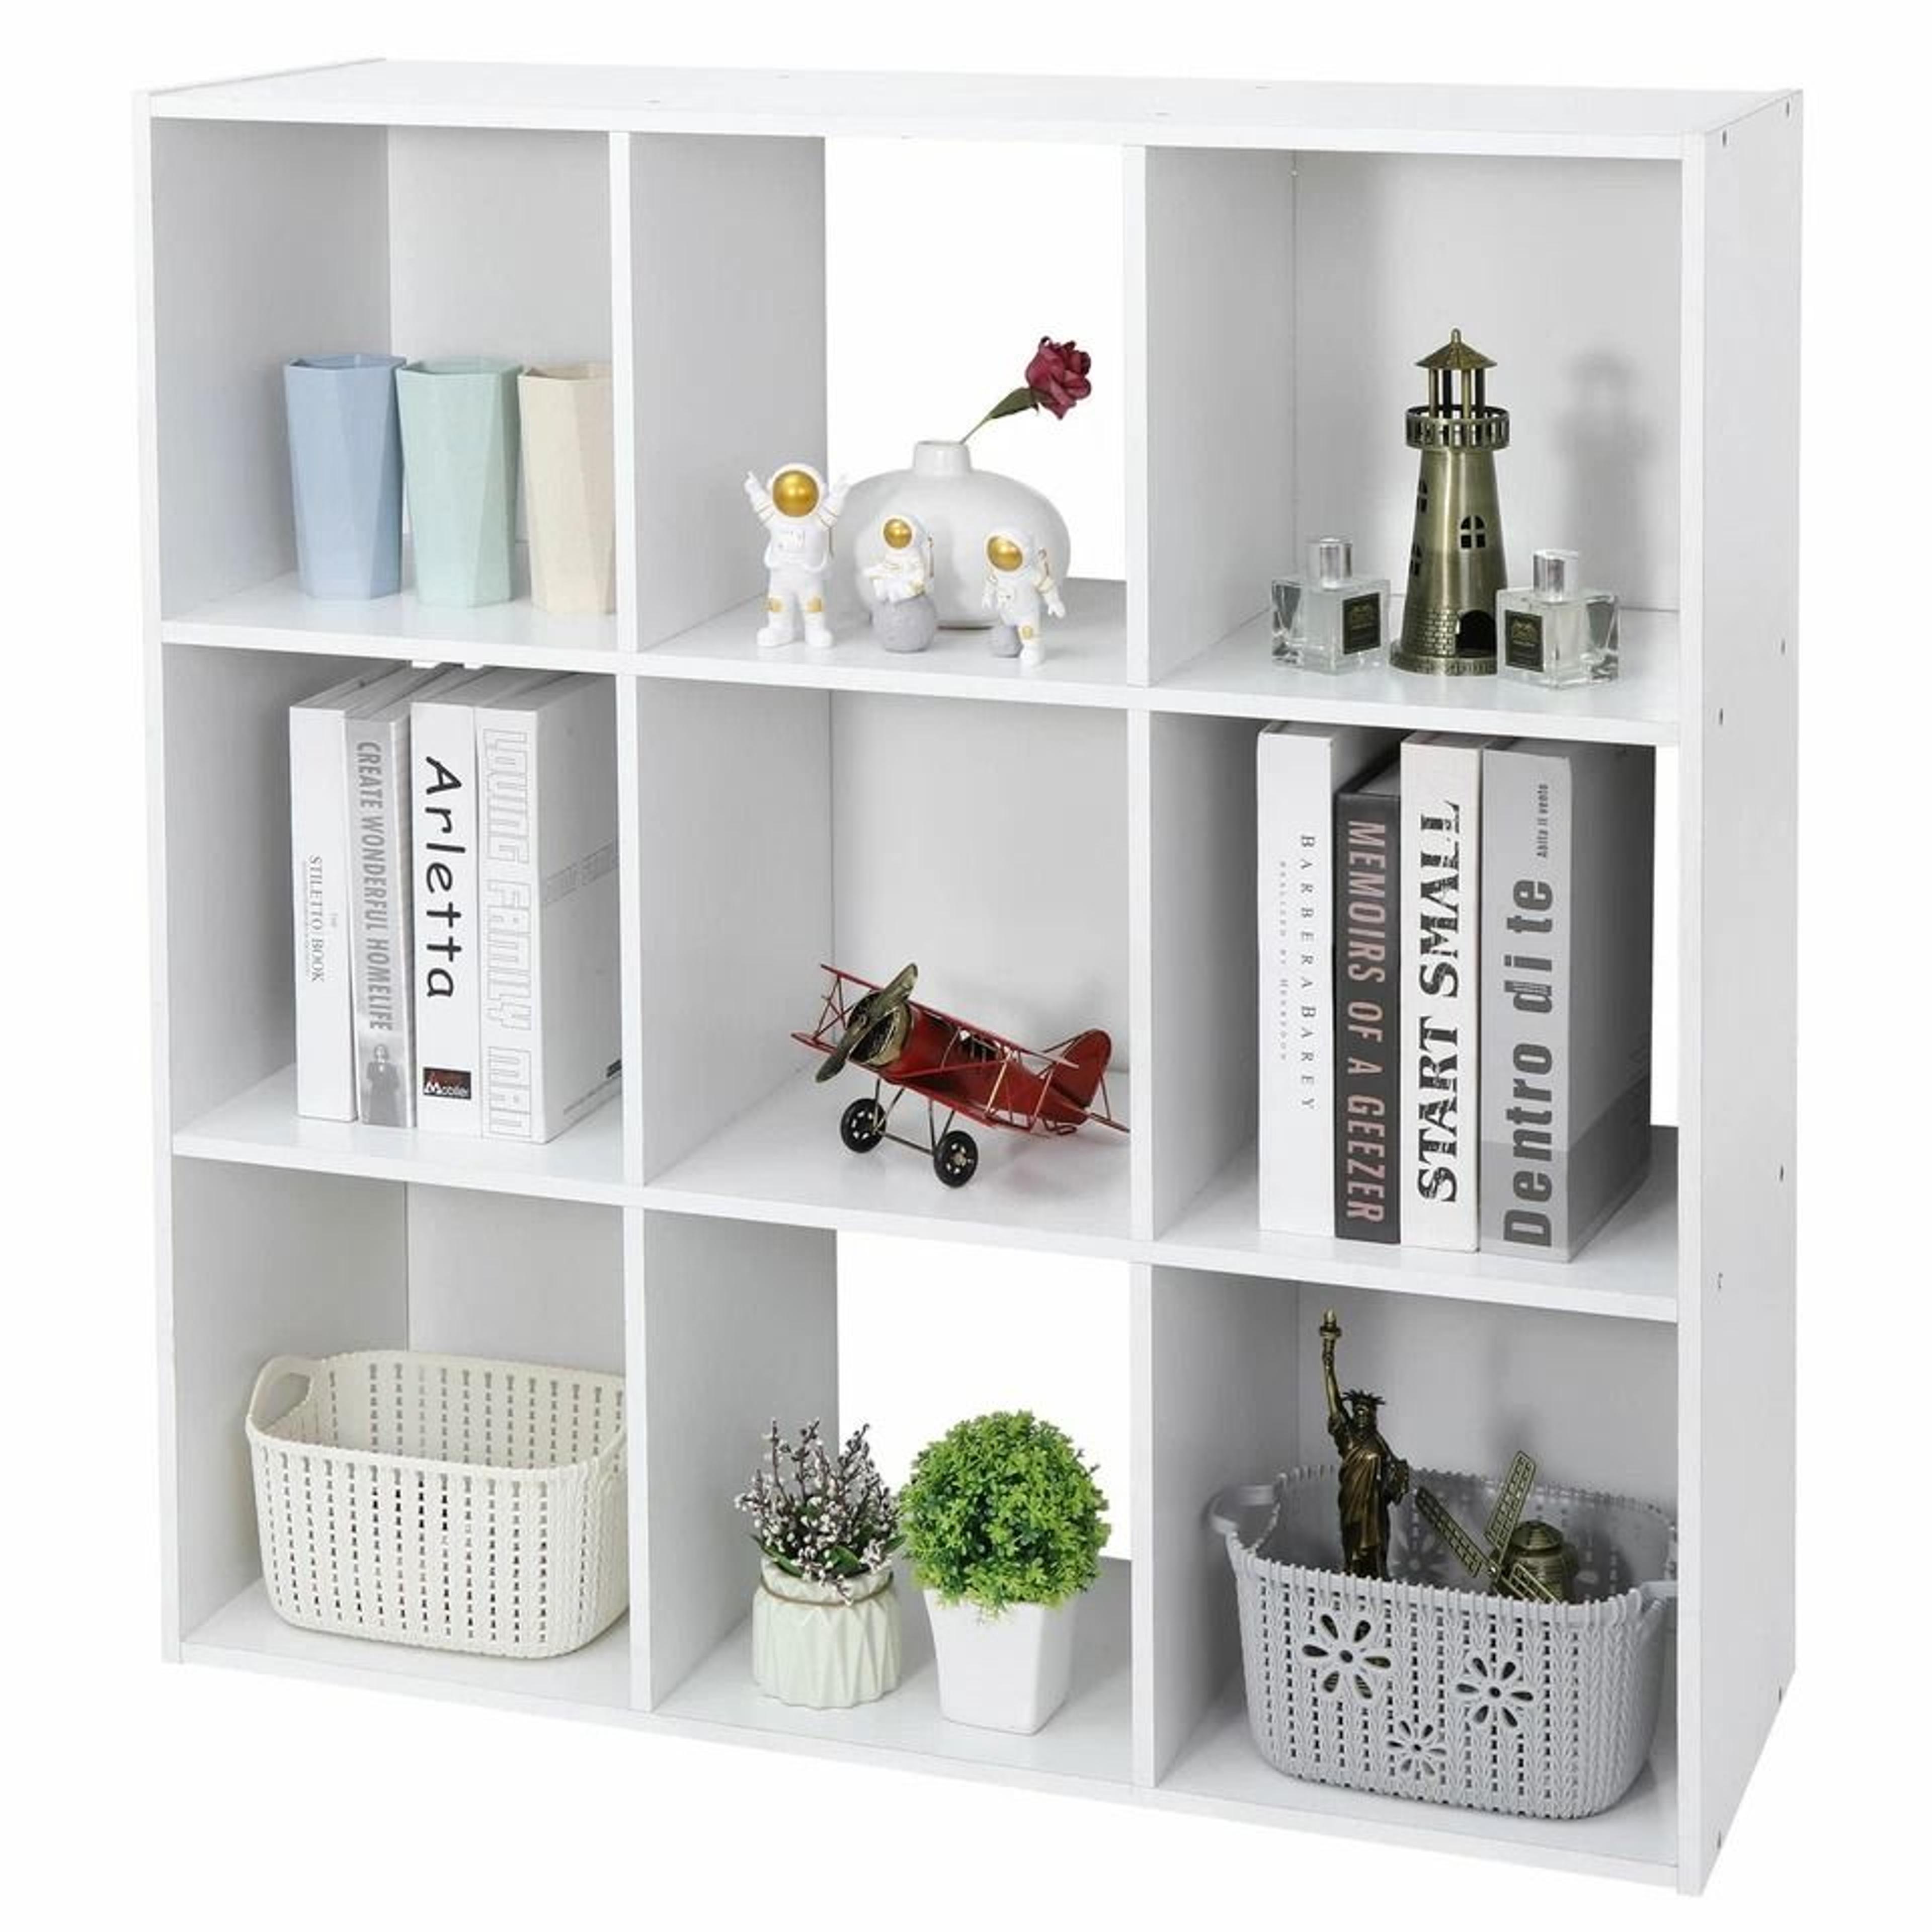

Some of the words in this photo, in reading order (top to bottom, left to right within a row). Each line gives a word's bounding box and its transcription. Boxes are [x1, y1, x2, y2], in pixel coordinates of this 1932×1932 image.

[356, 742, 382, 809] CREATE
[309, 855, 324, 931] STILETTO
[361, 816, 388, 930] WONDERFUL
[425, 756, 466, 997] Arletta
[1348, 821, 1385, 982] MEMOIRS
[1419, 800, 1460, 998] SMALL
[1506, 879, 1554, 934] te
[311, 938, 325, 983] BOOK
[366, 938, 392, 1030] HOMELIFE
[486, 879, 532, 1031] FAMILY
[1503, 955, 1553, 1013] di
[1347, 1001, 1383, 1042] OF
[1347, 1057, 1383, 1074] A
[1347, 1095, 1385, 1223] GEEZER
[1417, 1016, 1459, 1202] START
[1503, 1043, 1553, 1247] Dentro
